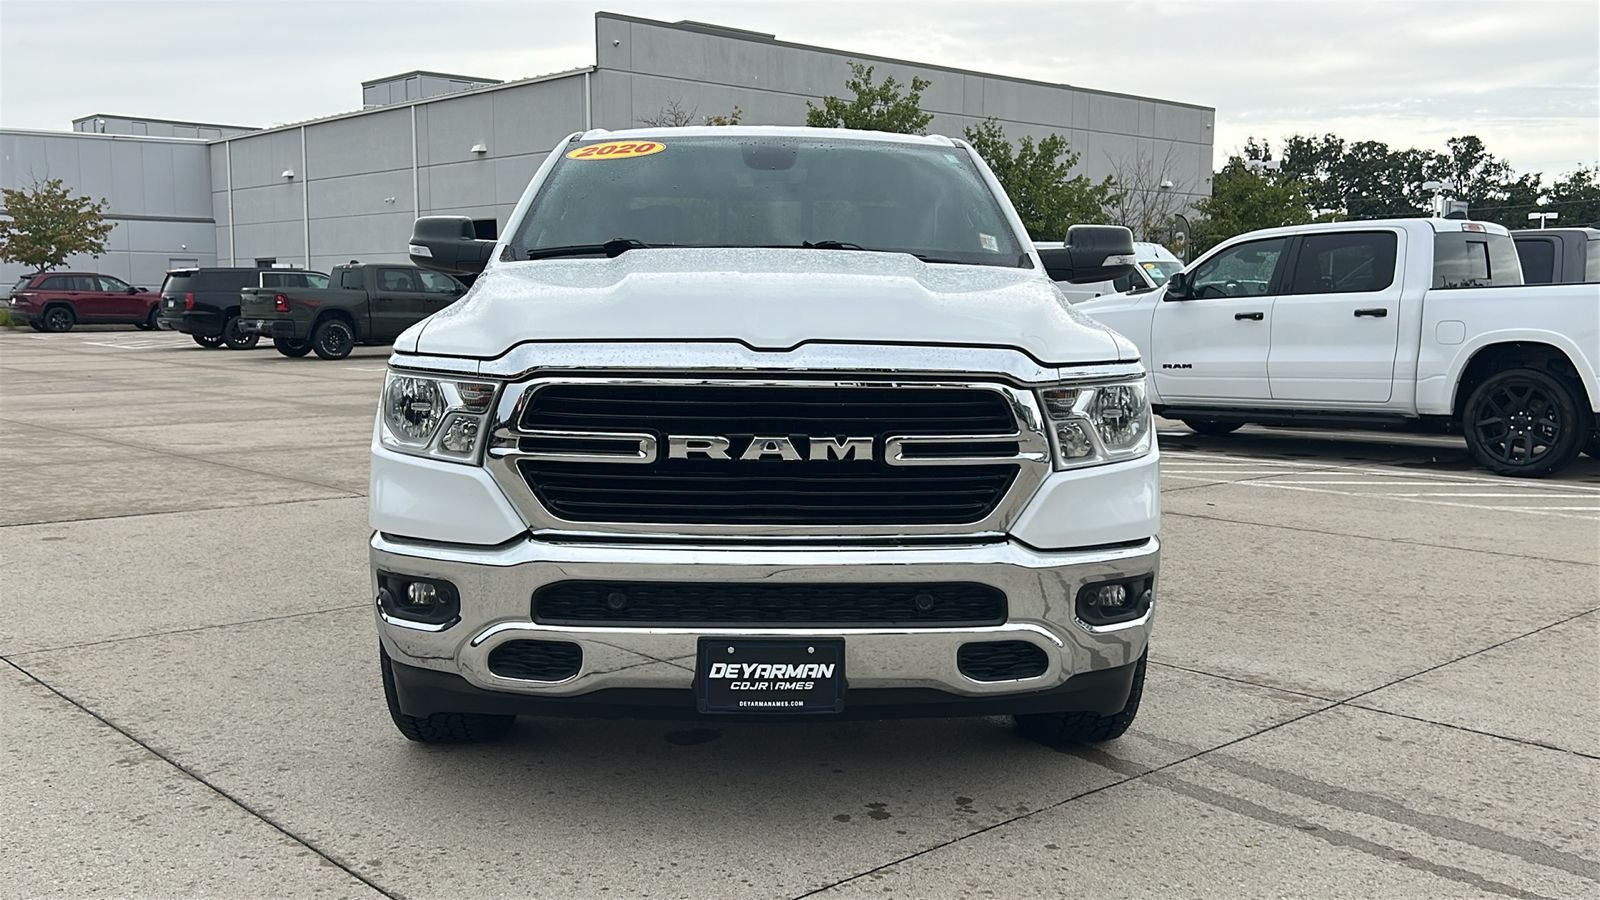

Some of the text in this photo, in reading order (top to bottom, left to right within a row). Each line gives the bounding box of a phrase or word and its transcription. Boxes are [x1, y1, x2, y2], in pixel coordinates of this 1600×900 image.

[575, 143, 657, 158] 2020
[668, 434, 874, 461] RAM
[708, 662, 836, 679] DEYARMAN
[730, 681, 769, 690] CDJR
